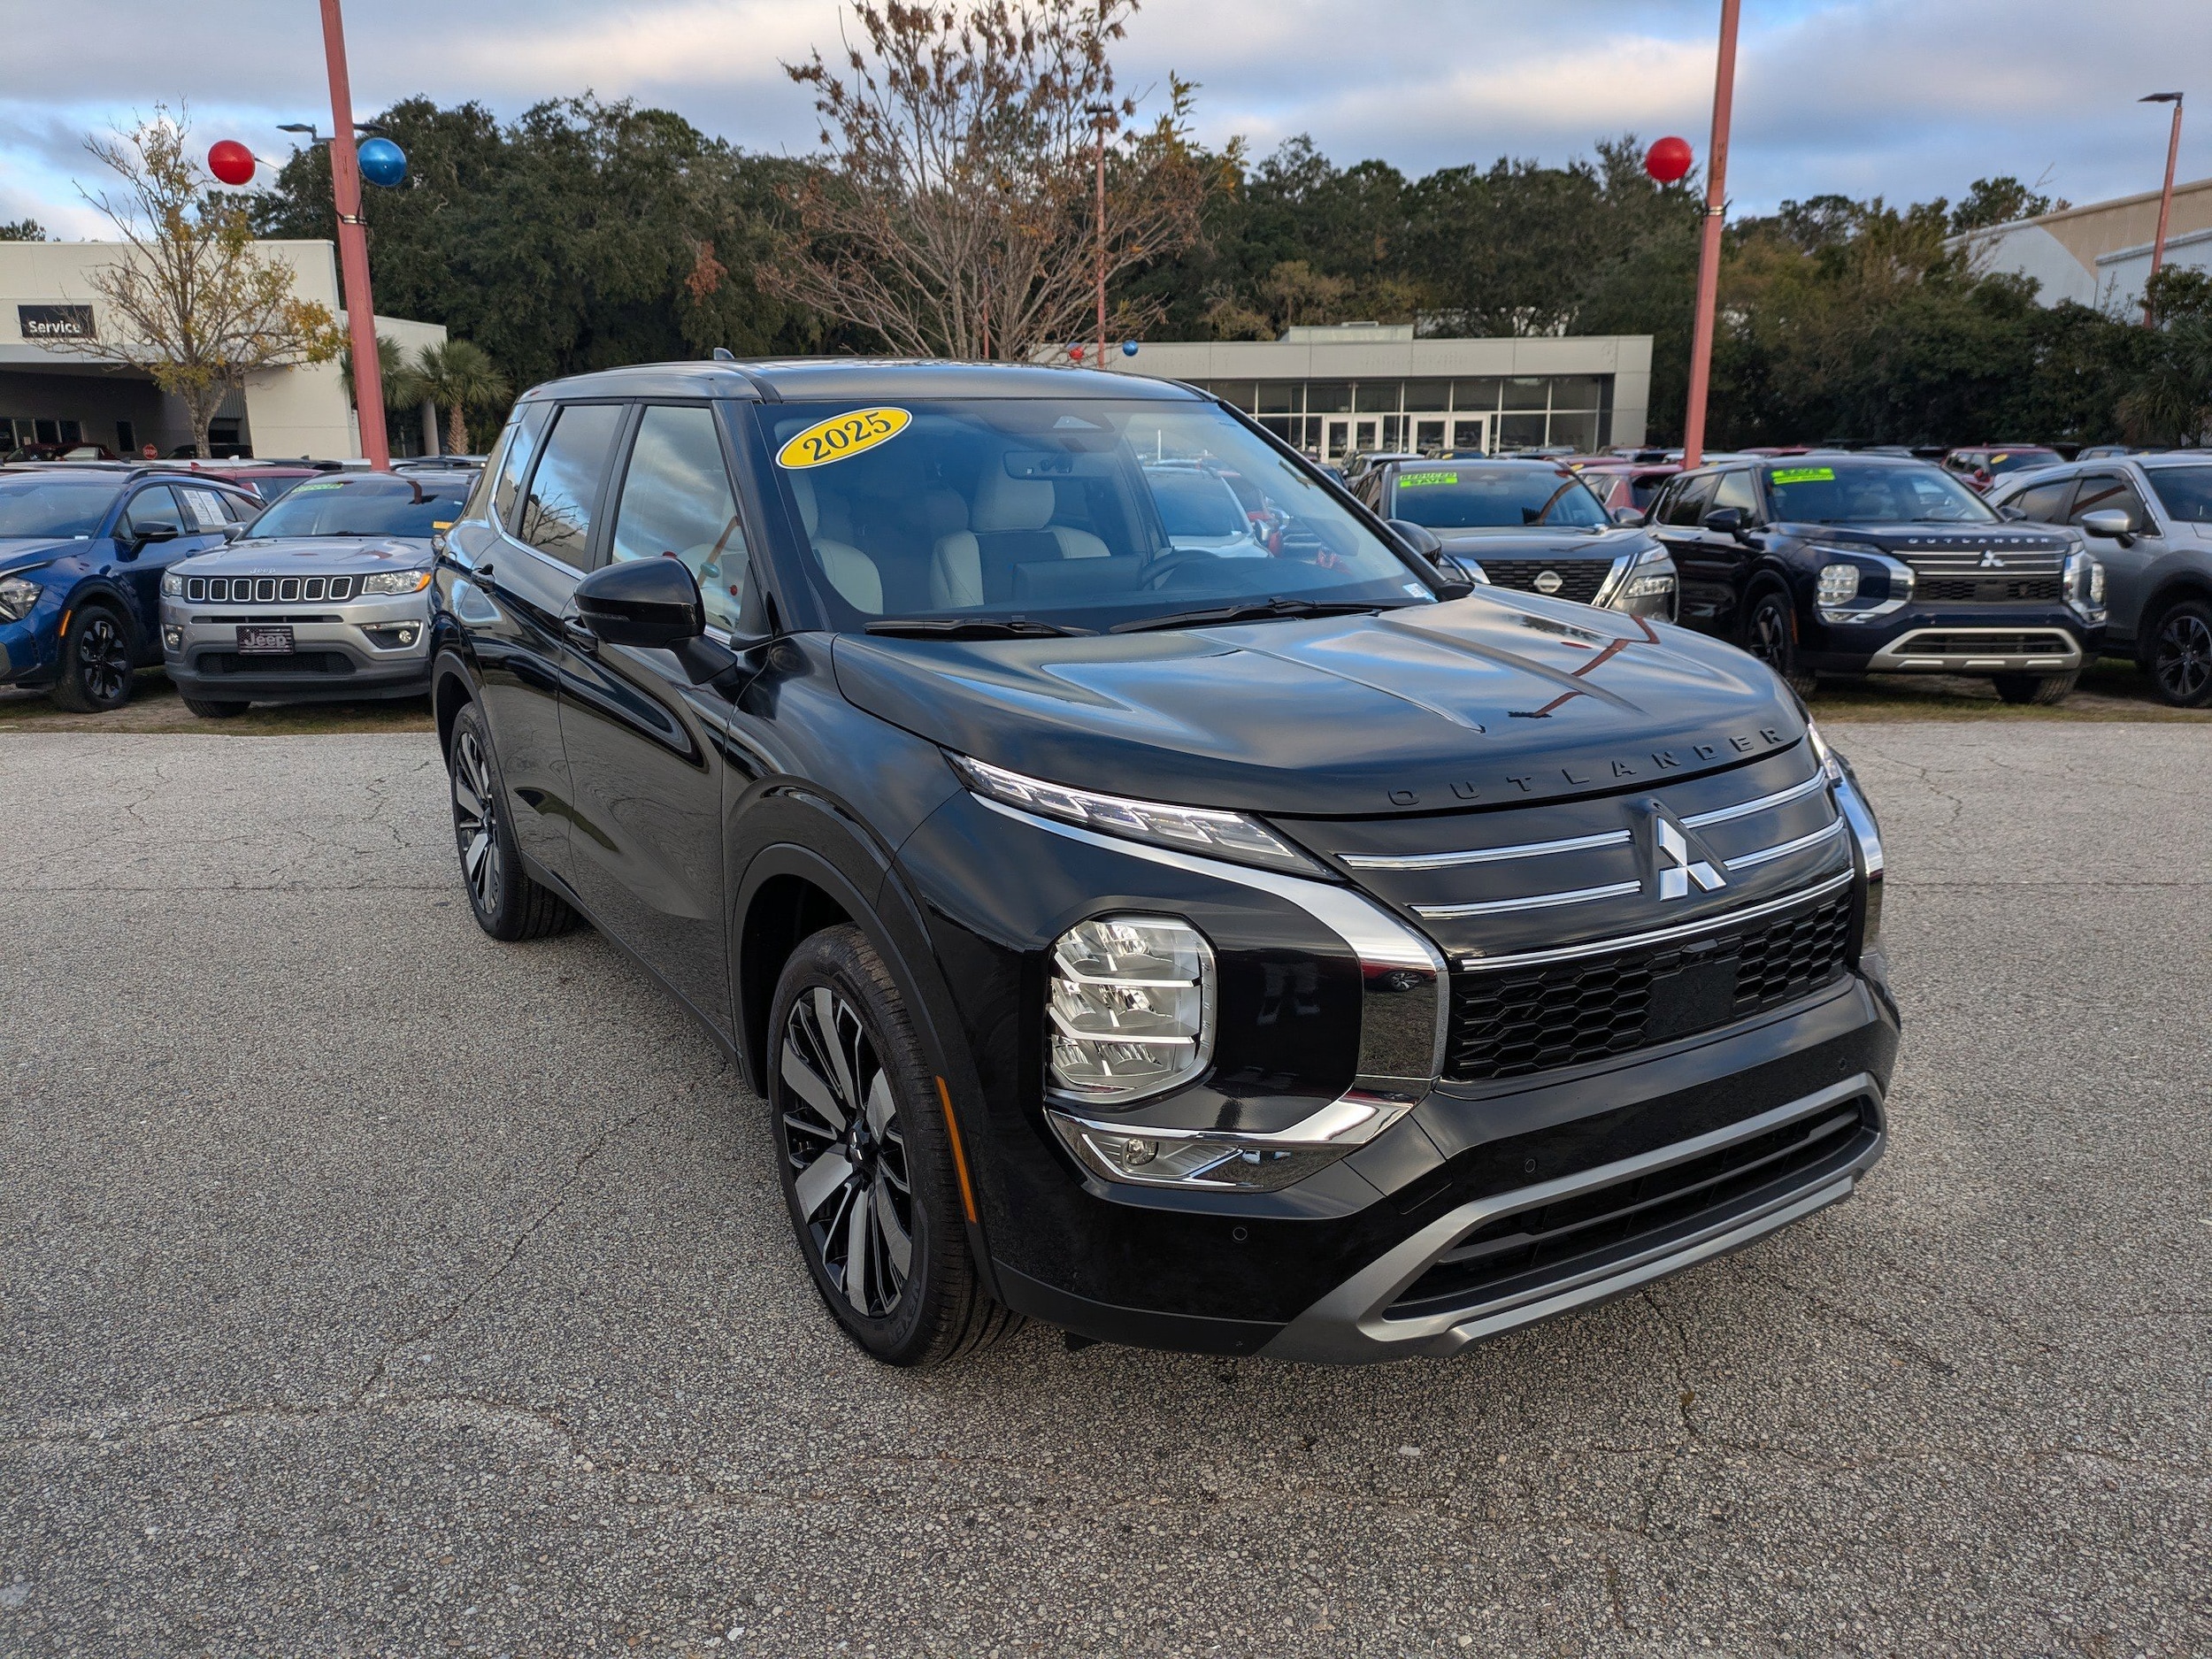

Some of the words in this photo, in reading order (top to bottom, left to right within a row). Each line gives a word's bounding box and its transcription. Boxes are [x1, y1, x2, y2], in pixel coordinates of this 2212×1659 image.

[28, 319, 81, 334] Service
[803, 411, 892, 461] 2025
[243, 632, 288, 647] Jeep
[1387, 726, 1786, 806] OUTLANDER
